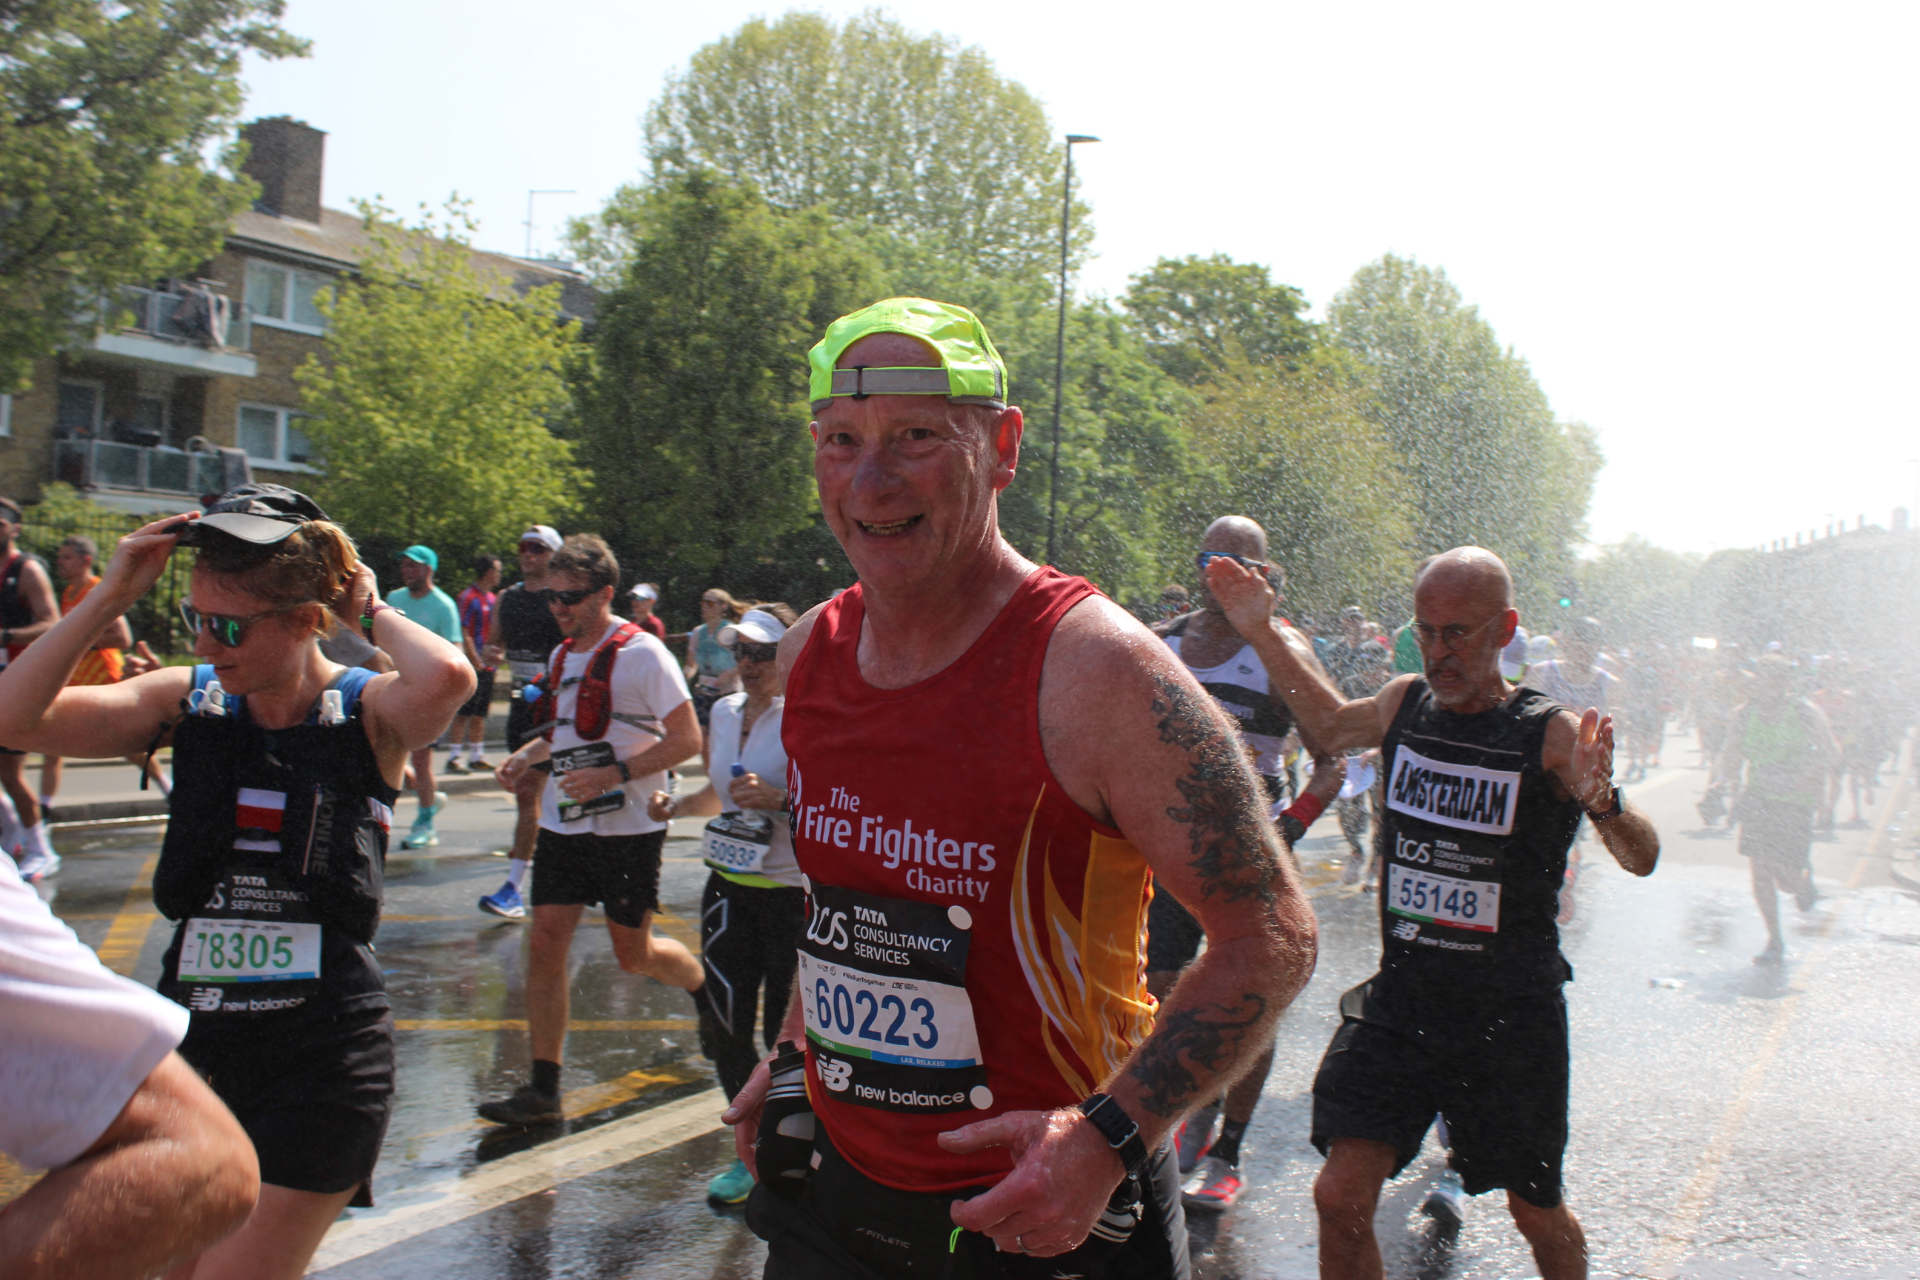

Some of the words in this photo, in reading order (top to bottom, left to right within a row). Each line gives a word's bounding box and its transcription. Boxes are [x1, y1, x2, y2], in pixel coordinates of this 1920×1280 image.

[830, 786, 860, 812] The
[1393, 760, 1511, 826] AMSTERDAM
[805, 804, 852, 848] Fire
[858, 815, 996, 872] Fighters
[1395, 831, 1431, 864] tcs
[1435, 840, 1461, 851] TATA
[1432, 858, 1471, 873] SERVICES
[1433, 850, 1495, 866] CONSULTANCY
[232, 875, 267, 887] TATA
[906, 867, 990, 902] Charity
[230, 900, 282, 912] SERVICES
[1399, 877, 1479, 919] 55148
[853, 905, 888, 927] TATA
[853, 924, 952, 953] CONSULTANCY
[1439, 939, 1484, 951] balance
[196, 932, 293, 969] 78305
[854, 942, 910, 966] SERVICES
[222, 1001, 248, 1012] new
[815, 977, 939, 1050] 60223
[916, 1059, 946, 1067] RELAXED
[855, 1084, 886, 1101] new
[889, 1088, 965, 1106] balance
[866, 1229, 910, 1249] FITLETIC
